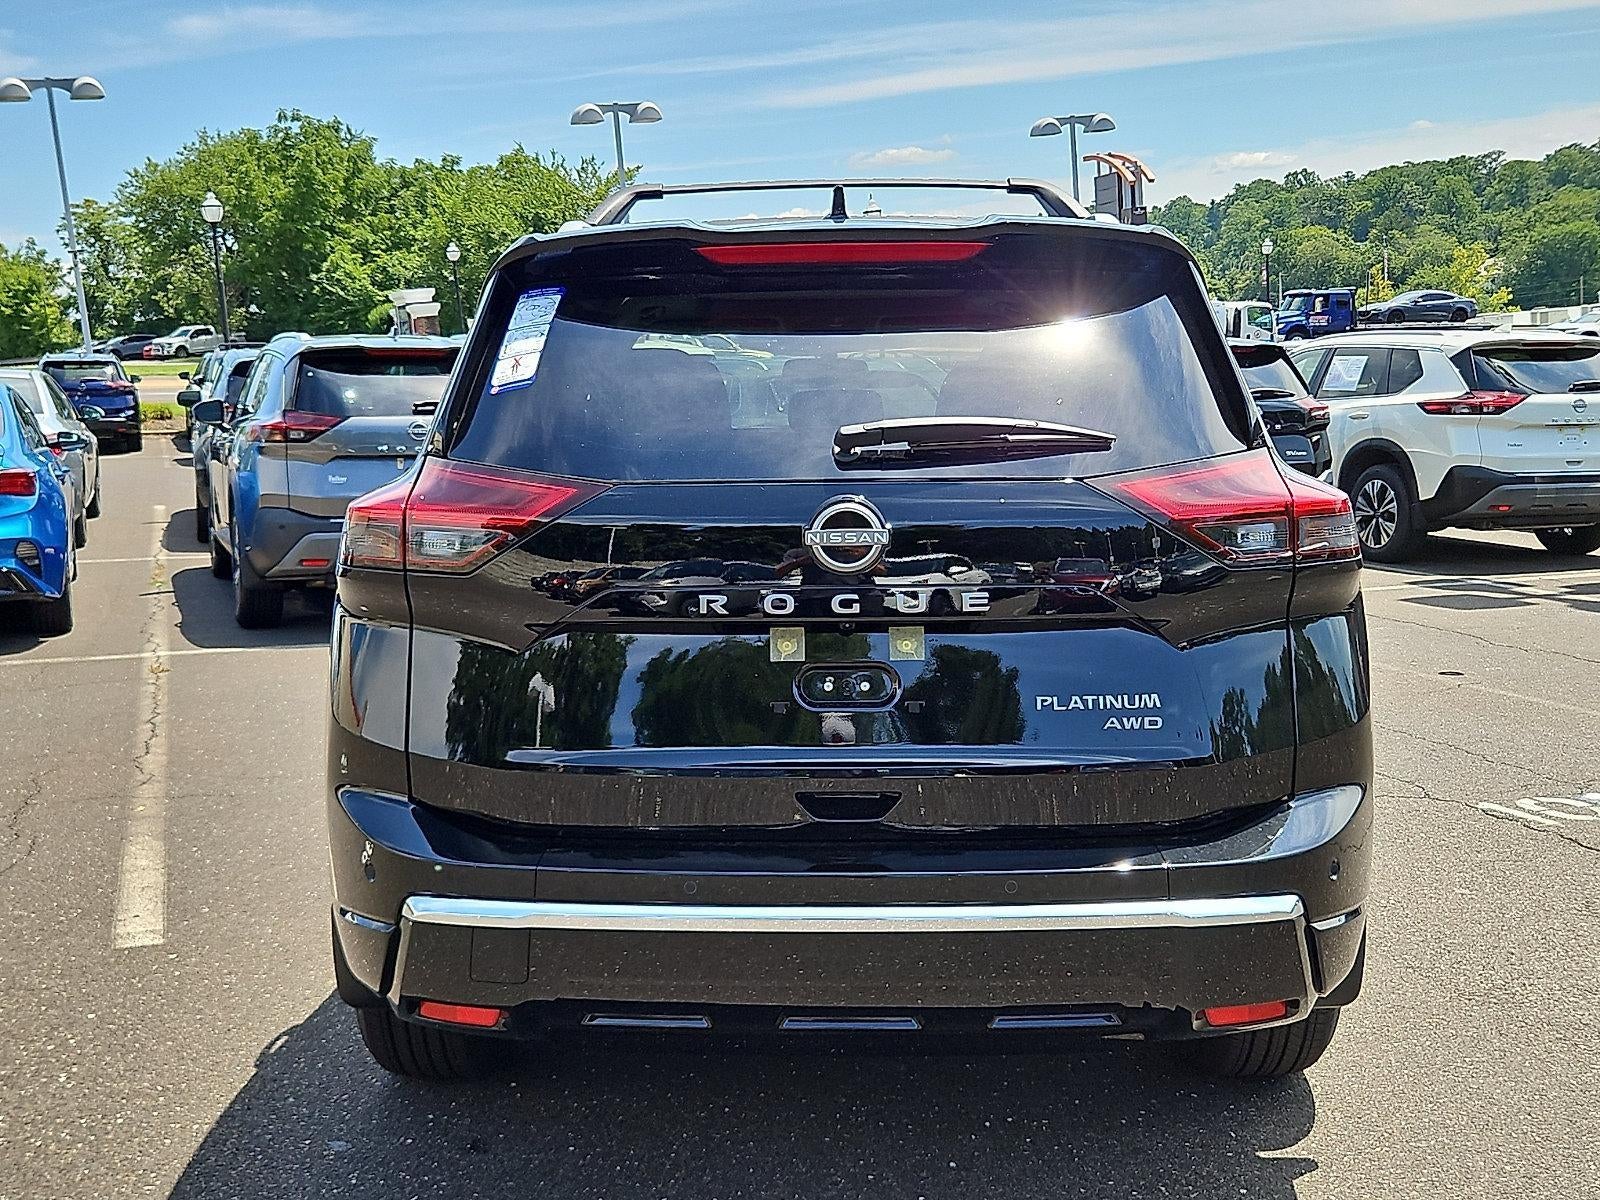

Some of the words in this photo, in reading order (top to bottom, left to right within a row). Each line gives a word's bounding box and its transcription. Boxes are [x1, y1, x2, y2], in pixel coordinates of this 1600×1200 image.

[807, 532, 887, 544] NISSAN
[698, 591, 991, 615] ROGUE
[1035, 693, 1162, 711] PLATINUM
[1103, 716, 1163, 731] AWD
